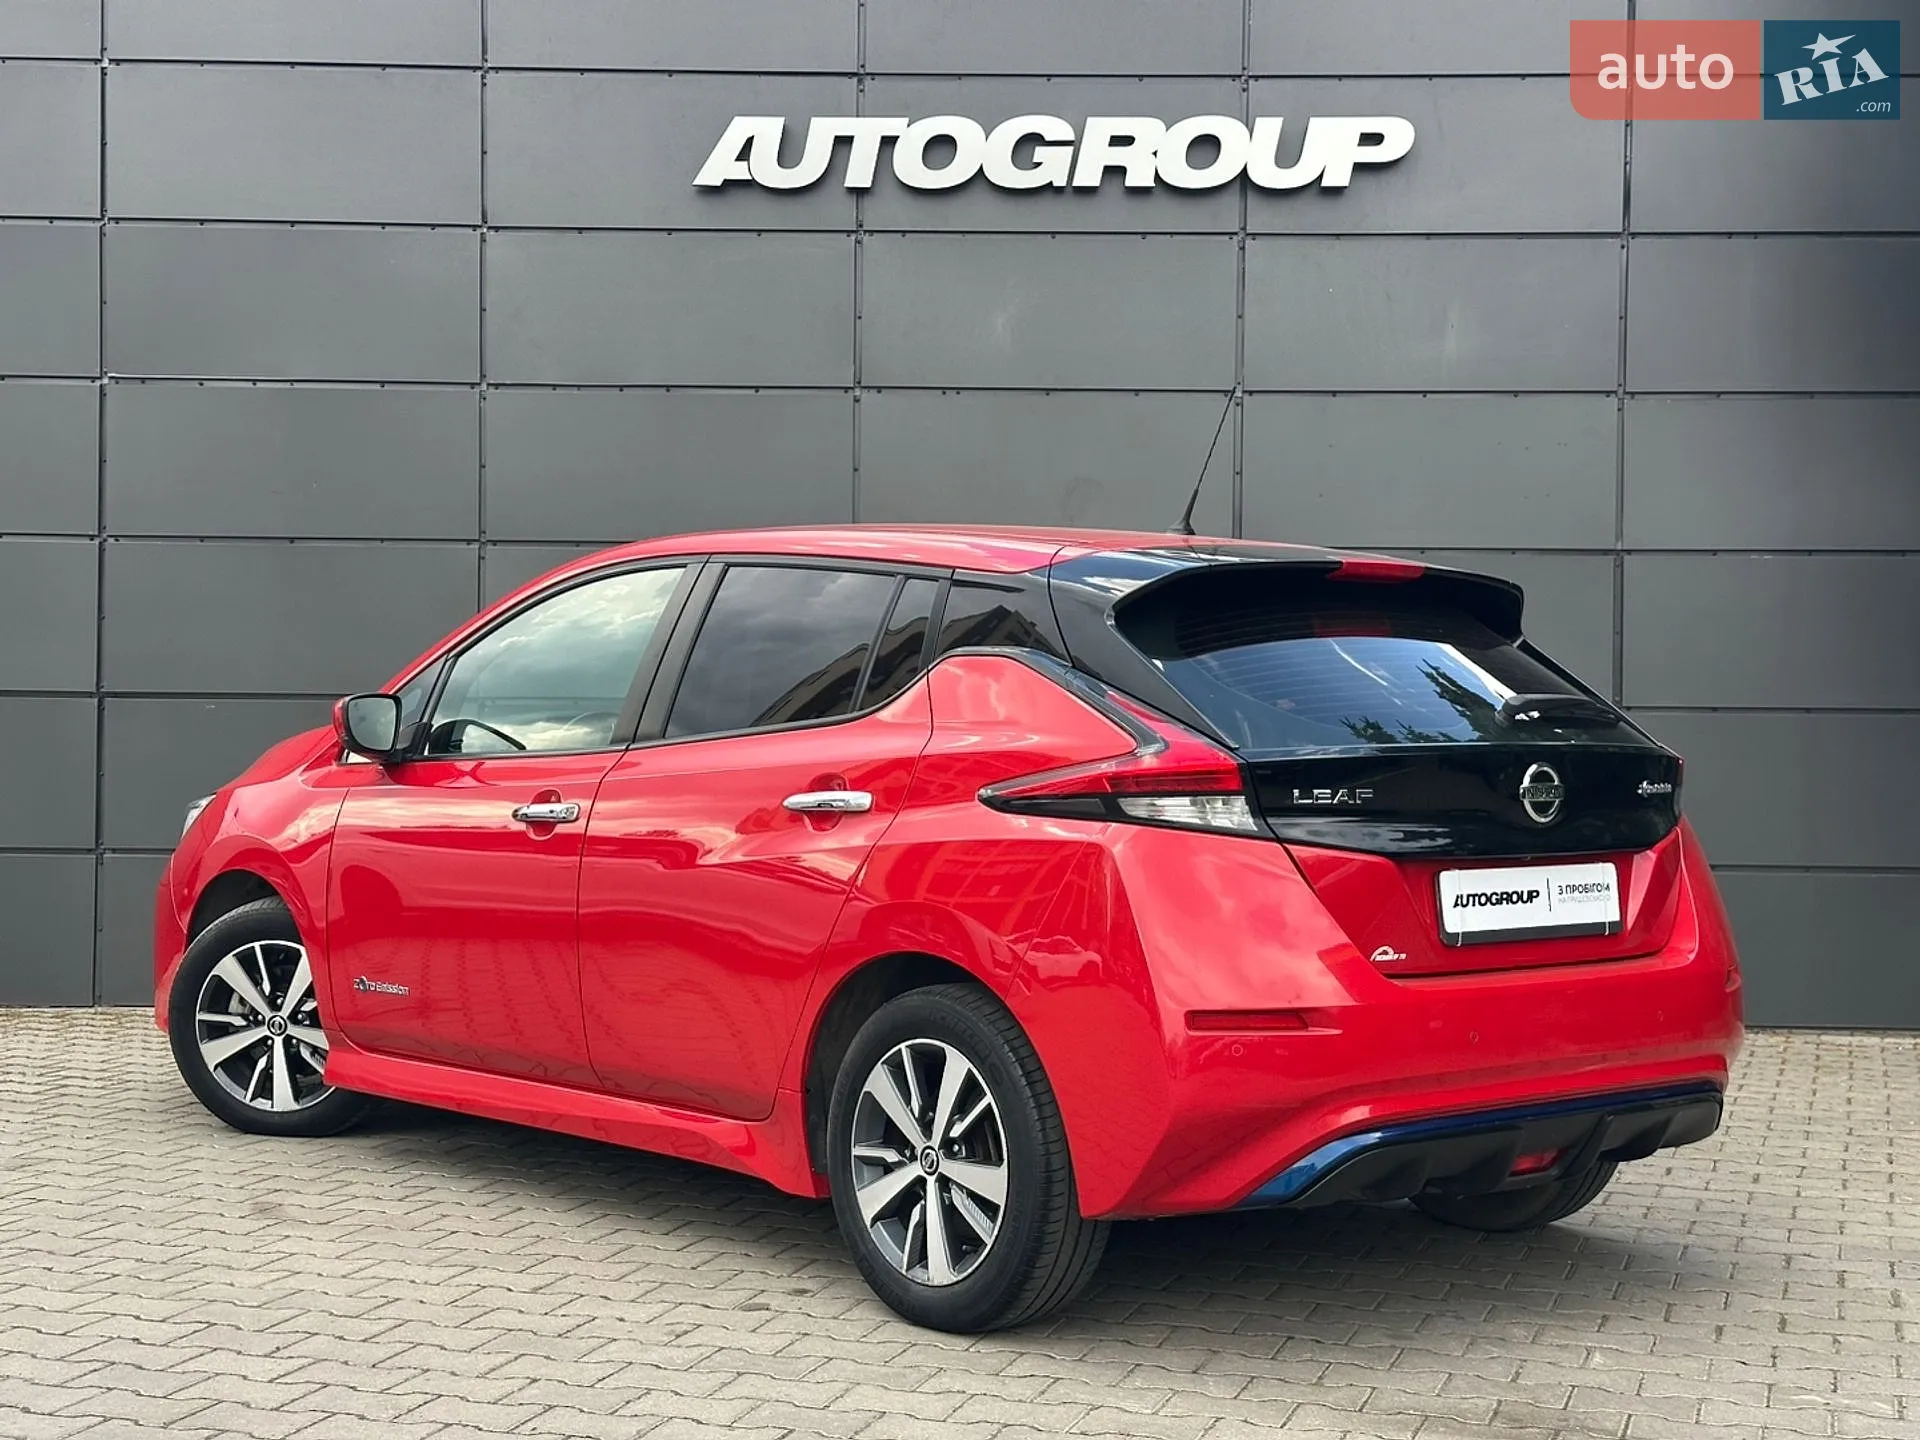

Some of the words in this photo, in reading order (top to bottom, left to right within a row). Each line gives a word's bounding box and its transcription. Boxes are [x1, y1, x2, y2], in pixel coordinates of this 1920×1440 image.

[692, 115, 1416, 193] AUTOGROUP
[1292, 788, 1374, 804] LEAF
[1453, 889, 1540, 909] AUTOGROUP
